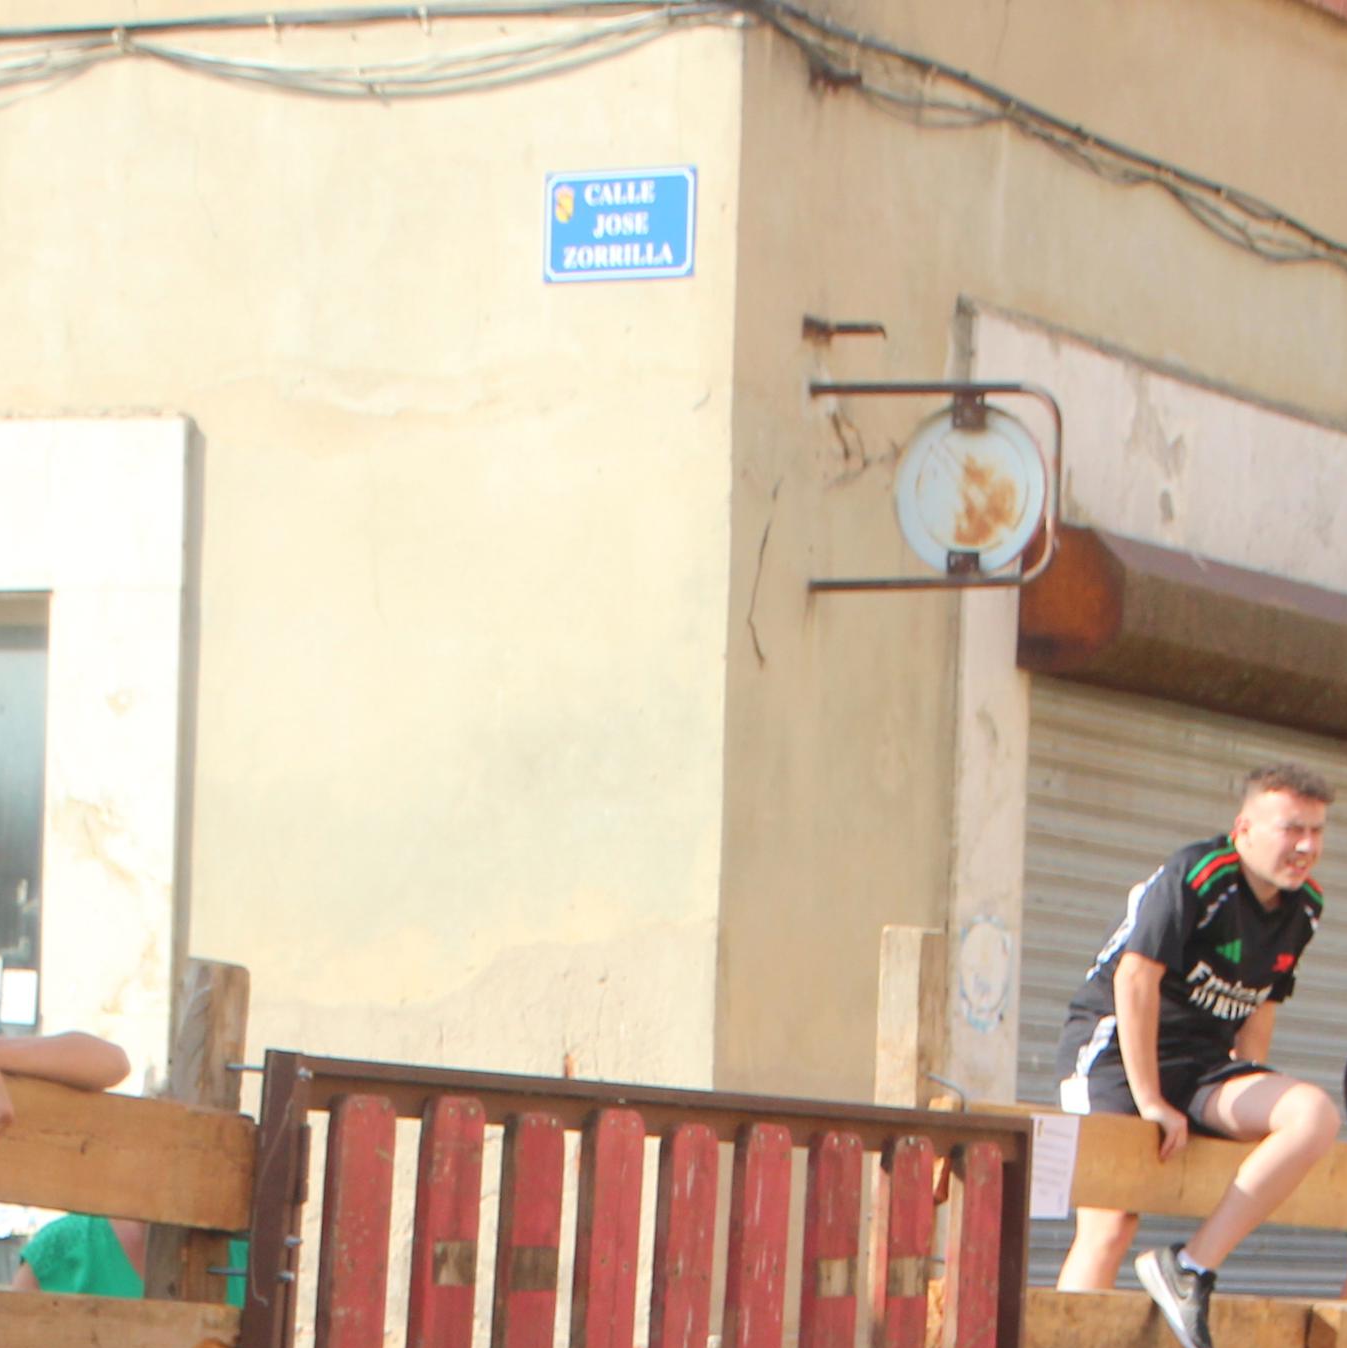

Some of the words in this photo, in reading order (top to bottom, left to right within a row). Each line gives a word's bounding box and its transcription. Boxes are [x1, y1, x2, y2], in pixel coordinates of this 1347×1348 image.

[584, 180, 656, 206] CALLE
[593, 211, 650, 238] JOSE
[563, 242, 673, 269] ZORRILLA
